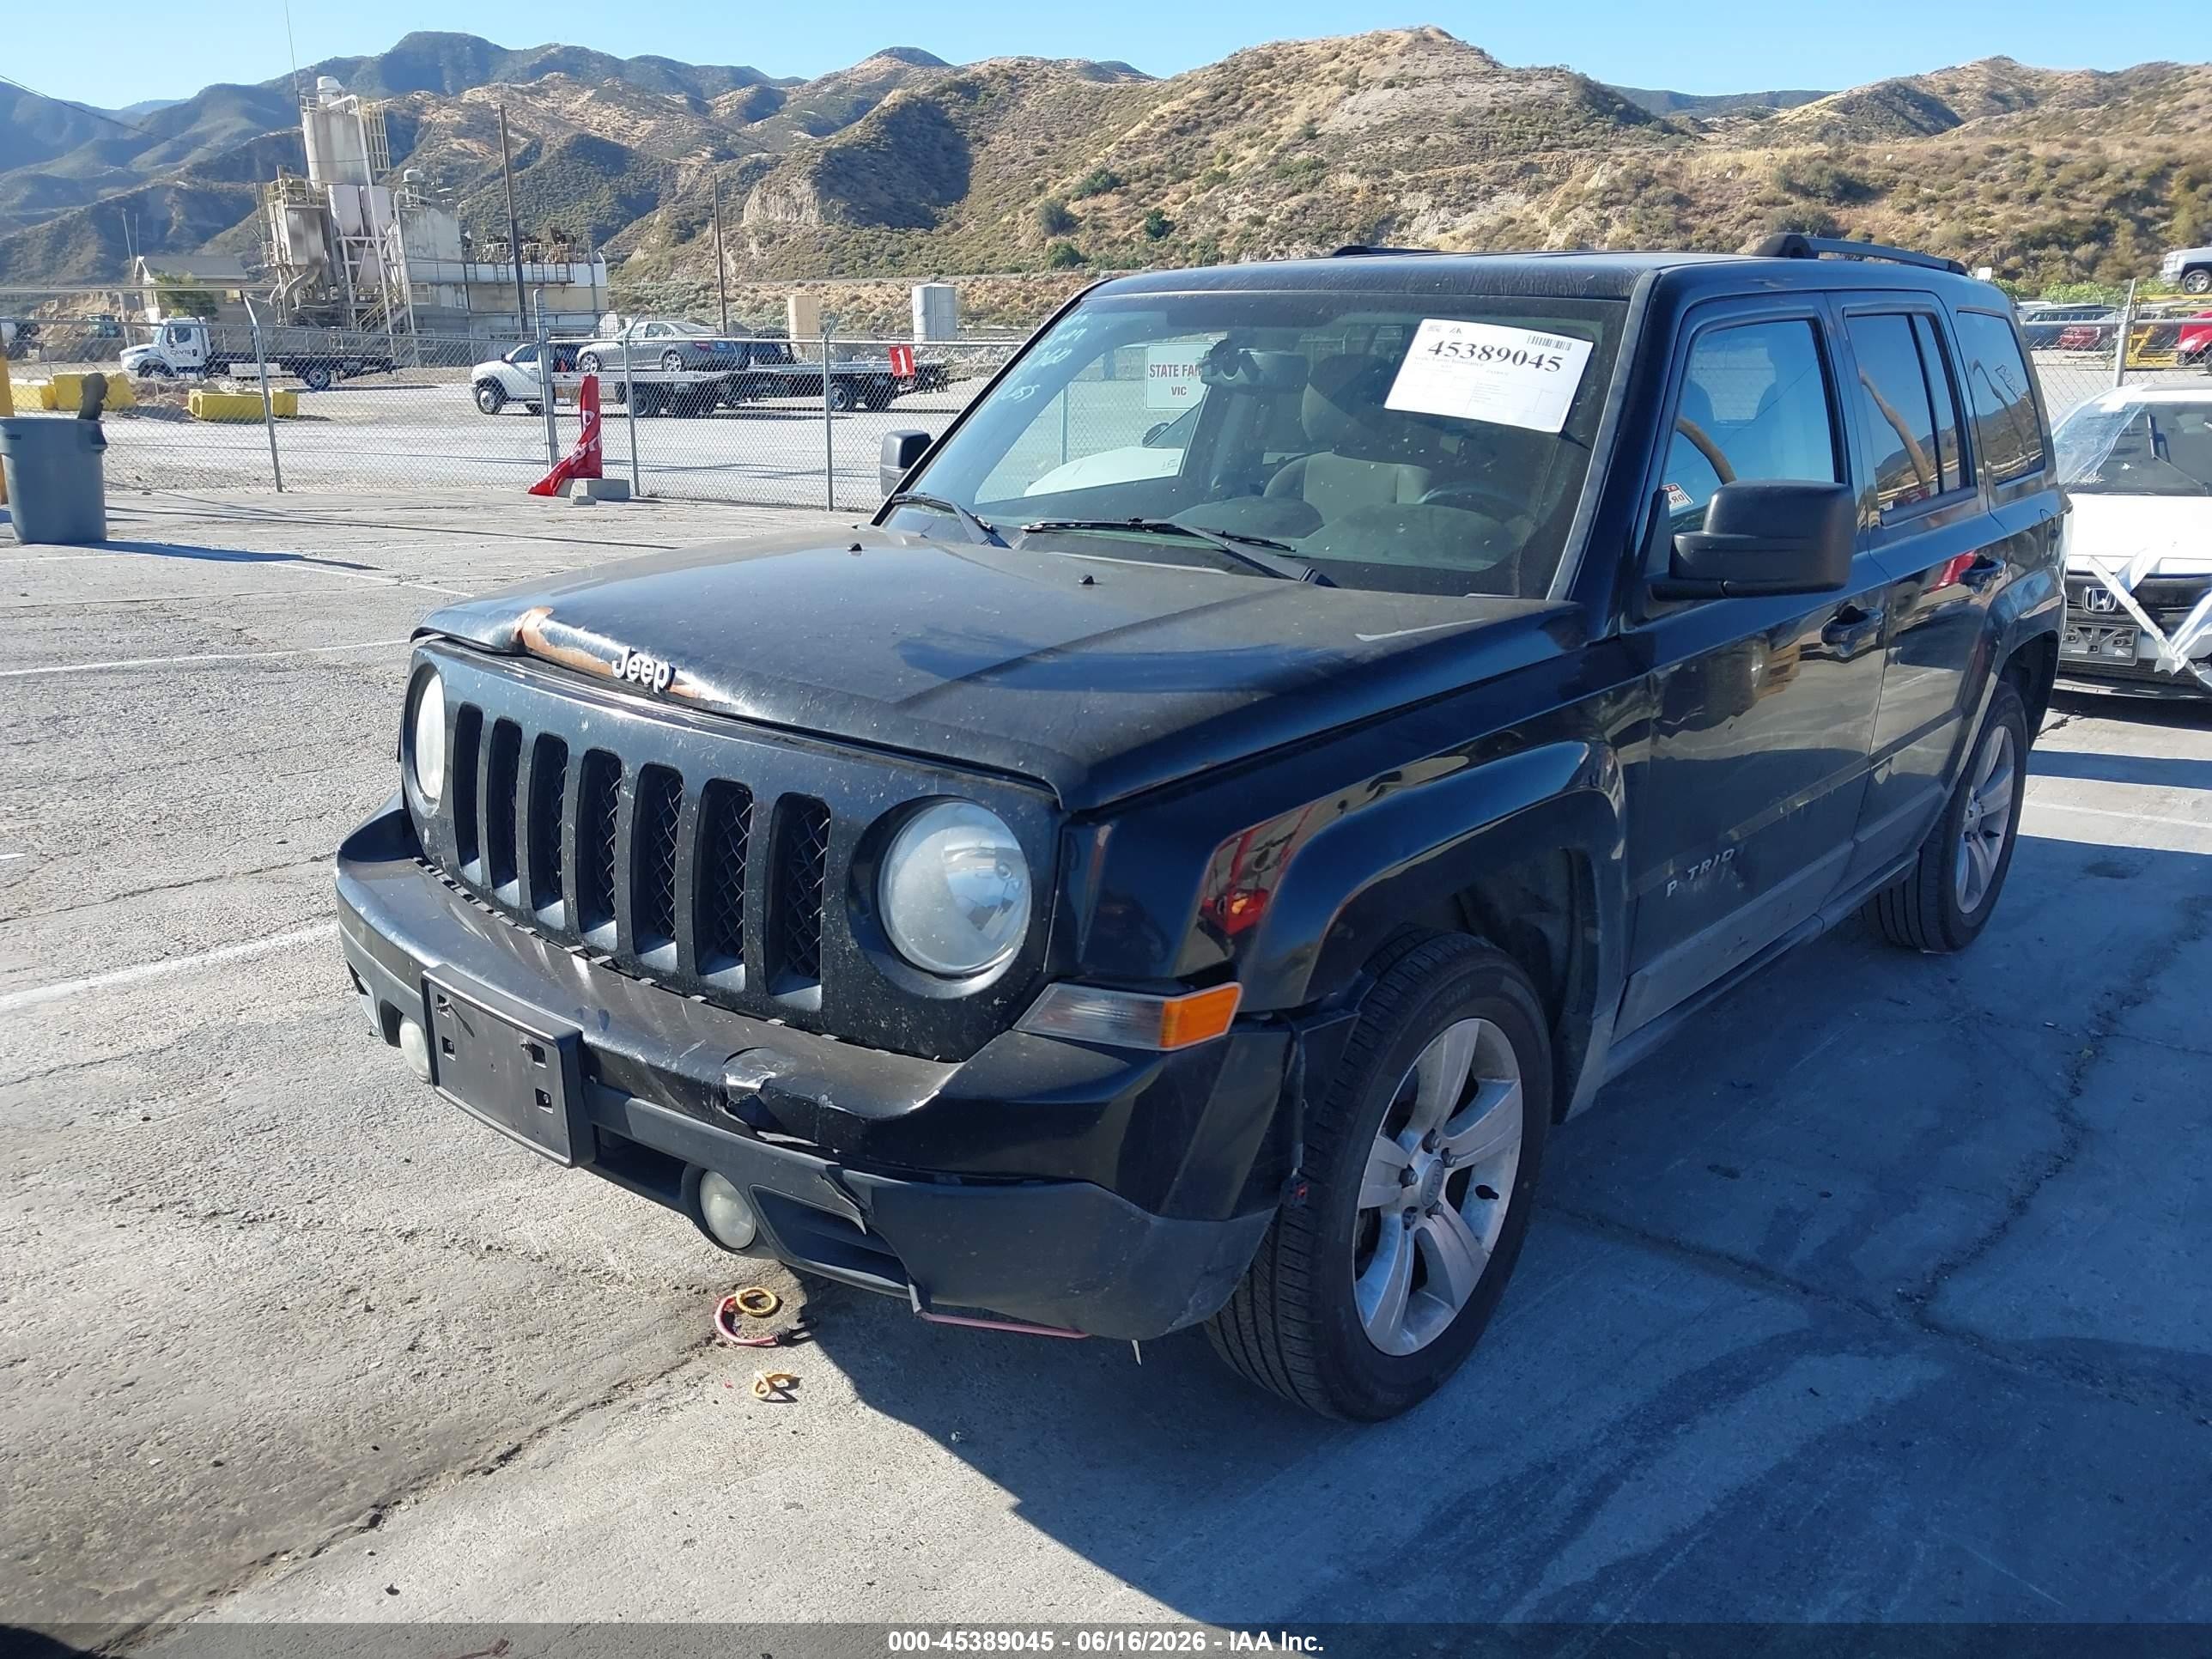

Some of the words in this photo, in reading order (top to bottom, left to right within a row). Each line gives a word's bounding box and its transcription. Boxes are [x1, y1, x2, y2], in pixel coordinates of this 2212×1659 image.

[896, 348, 910, 374] 1
[1427, 340, 1564, 373] 45389045
[1149, 364, 1179, 378] STATE
[1182, 364, 1201, 378] FAR
[1170, 386, 1187, 396] VIC
[611, 646, 670, 694] Jeep
